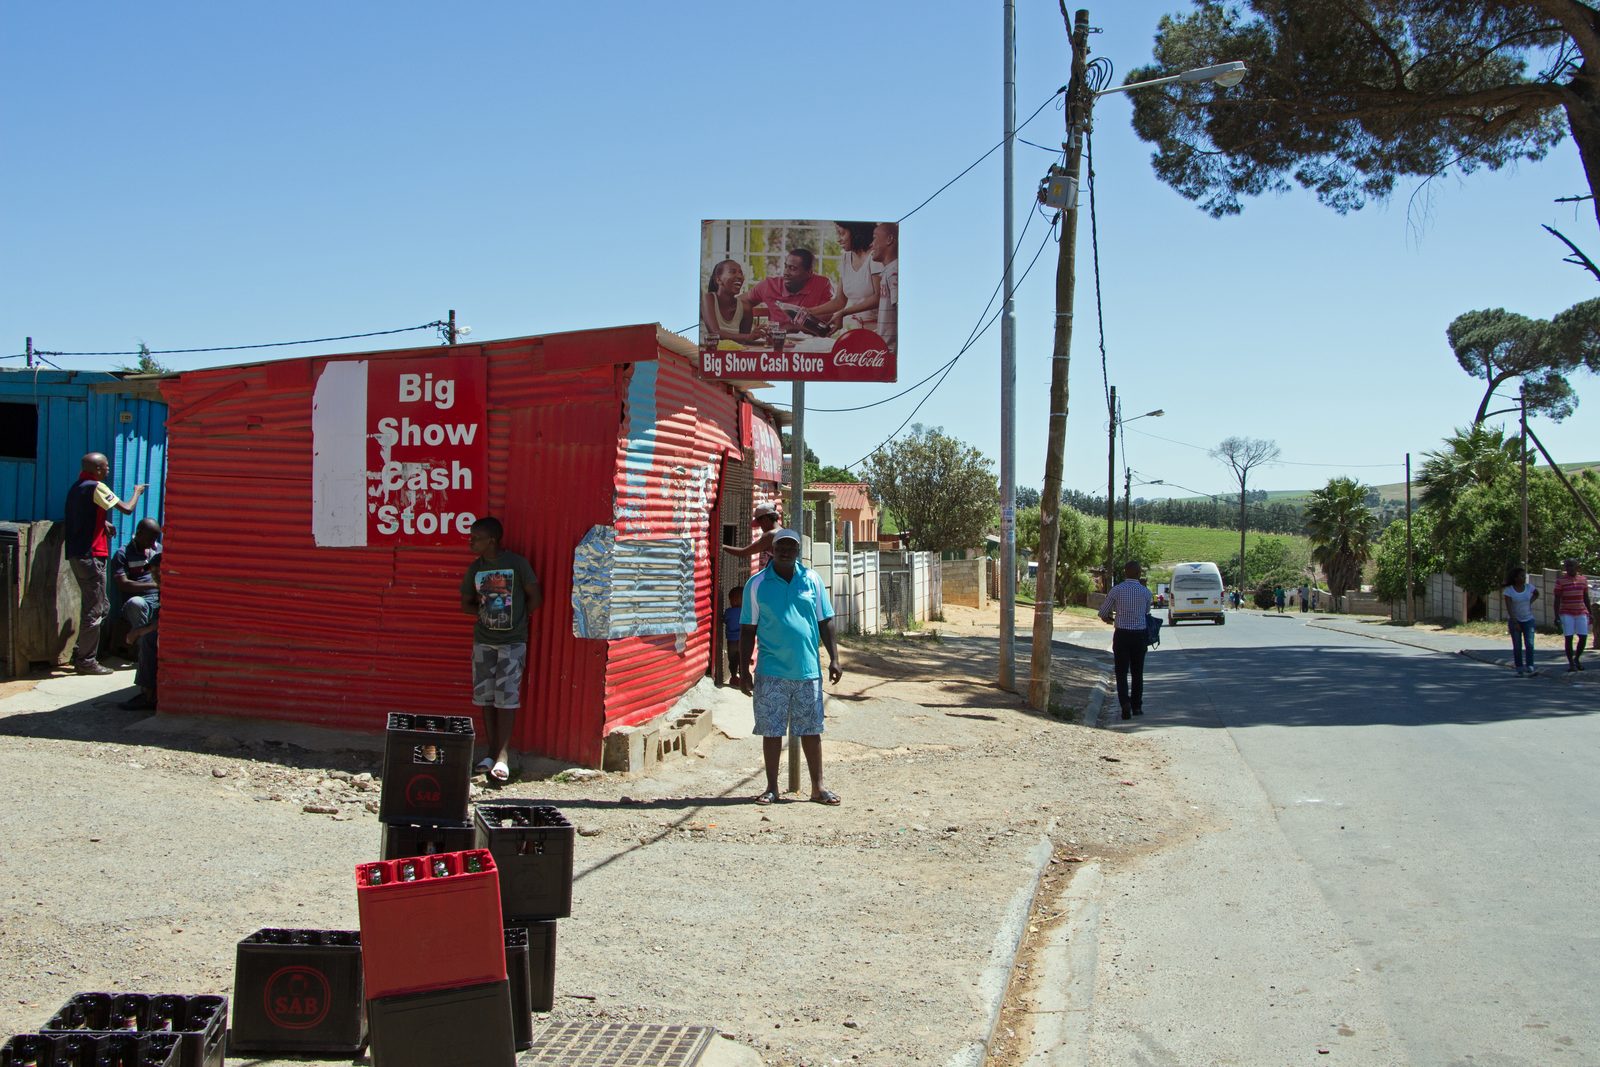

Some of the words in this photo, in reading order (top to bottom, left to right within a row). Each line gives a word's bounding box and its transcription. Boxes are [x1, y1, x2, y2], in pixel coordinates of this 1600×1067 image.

[703, 353, 722, 377] Big
[725, 352, 757, 372] Show
[760, 352, 789, 372] Cash
[792, 353, 824, 373] Store
[833, 348, 887, 367] Coca-Cola
[399, 372, 455, 410] Big
[377, 417, 478, 446] Show
[382, 460, 472, 491] Cash
[377, 504, 477, 535] Store
[275, 995, 319, 1015] SAB
